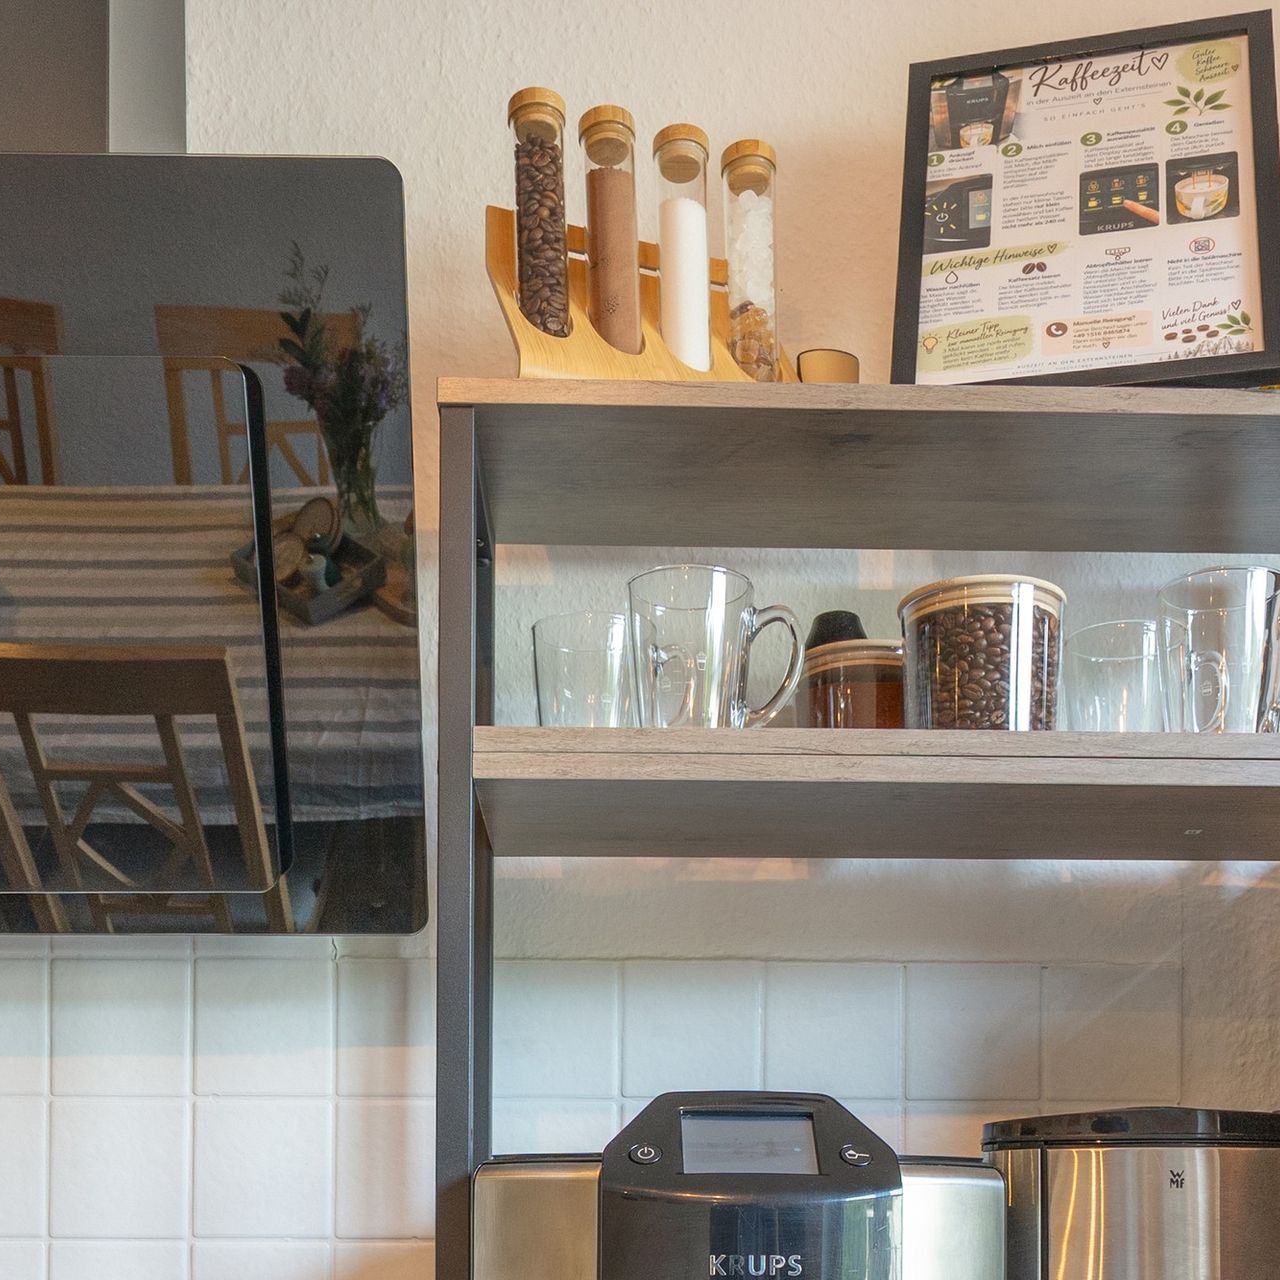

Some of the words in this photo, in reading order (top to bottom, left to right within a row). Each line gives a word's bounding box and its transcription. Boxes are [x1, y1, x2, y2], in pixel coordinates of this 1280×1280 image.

[1028, 50, 1157, 97] Kaffeezeit
[1096, 221, 1135, 232] KRUPS
[930, 255, 991, 275] Wichtige
[992, 248, 1044, 264] Hinweise
[1161, 305, 1191, 321] Vielen
[1193, 297, 1219, 312] Dank
[1161, 319, 1178, 331] und
[1180, 314, 1196, 326] viel
[709, 1254, 803, 1277] KRUPS
